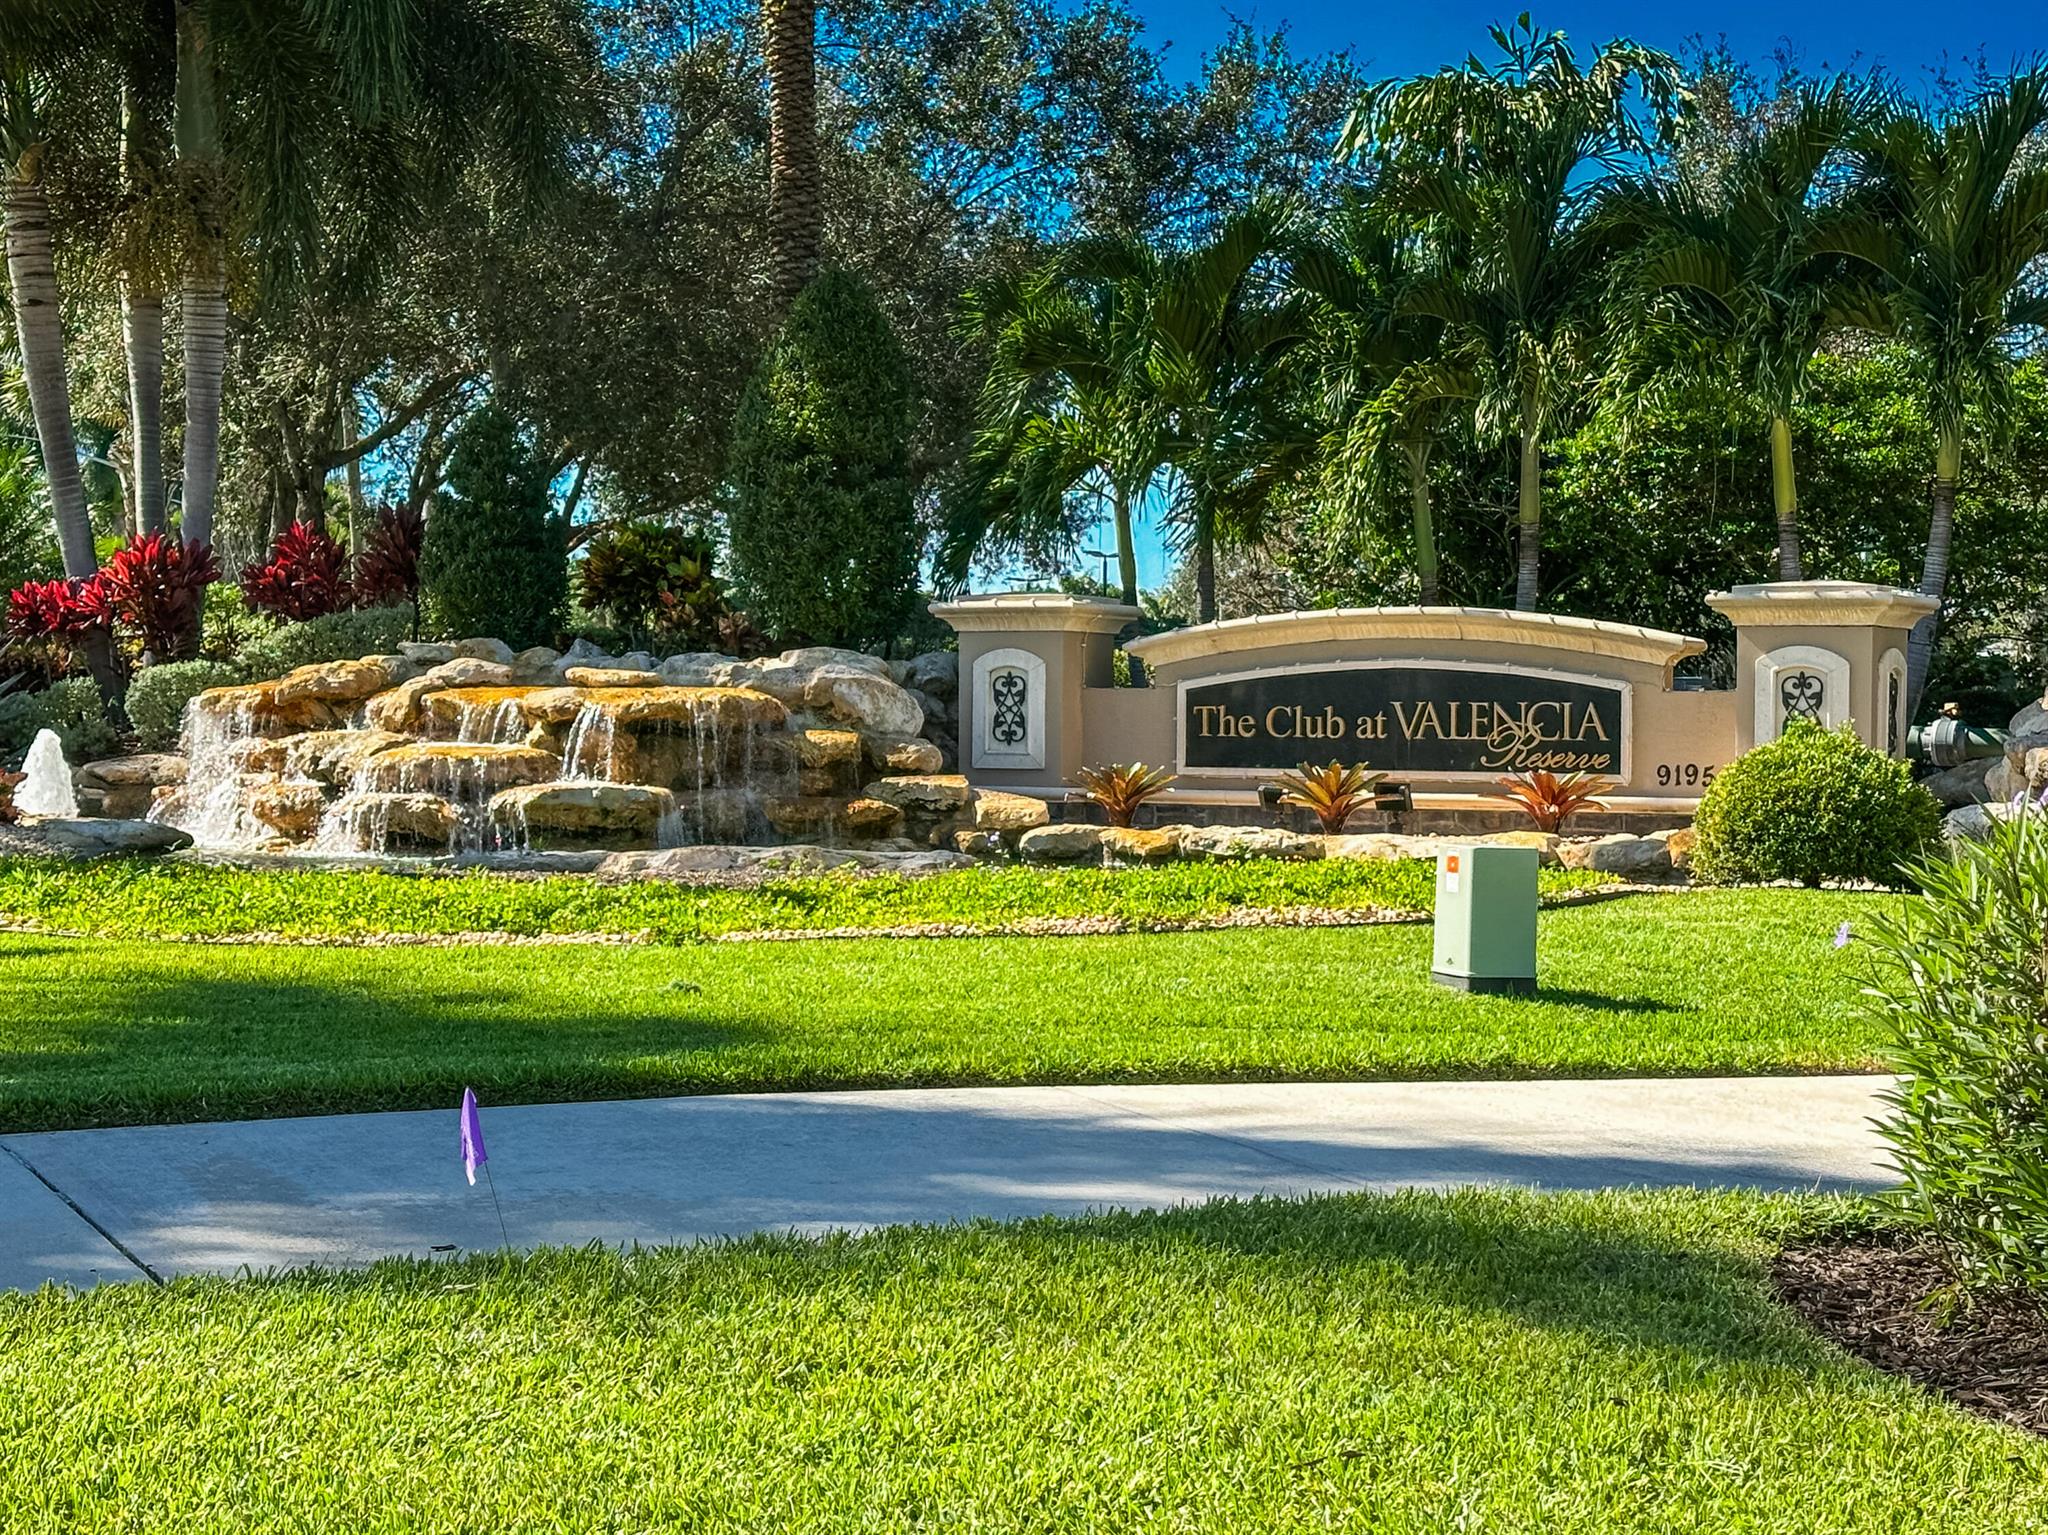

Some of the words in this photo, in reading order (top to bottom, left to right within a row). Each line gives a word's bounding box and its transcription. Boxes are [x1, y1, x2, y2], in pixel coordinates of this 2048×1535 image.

[1193, 705, 1256, 737] The
[1265, 705, 1346, 738] Club
[1355, 710, 1388, 738] at
[1390, 701, 1609, 741] VALENCIA
[1480, 721, 1611, 768] Reserve
[1656, 763, 1717, 787] 9195
